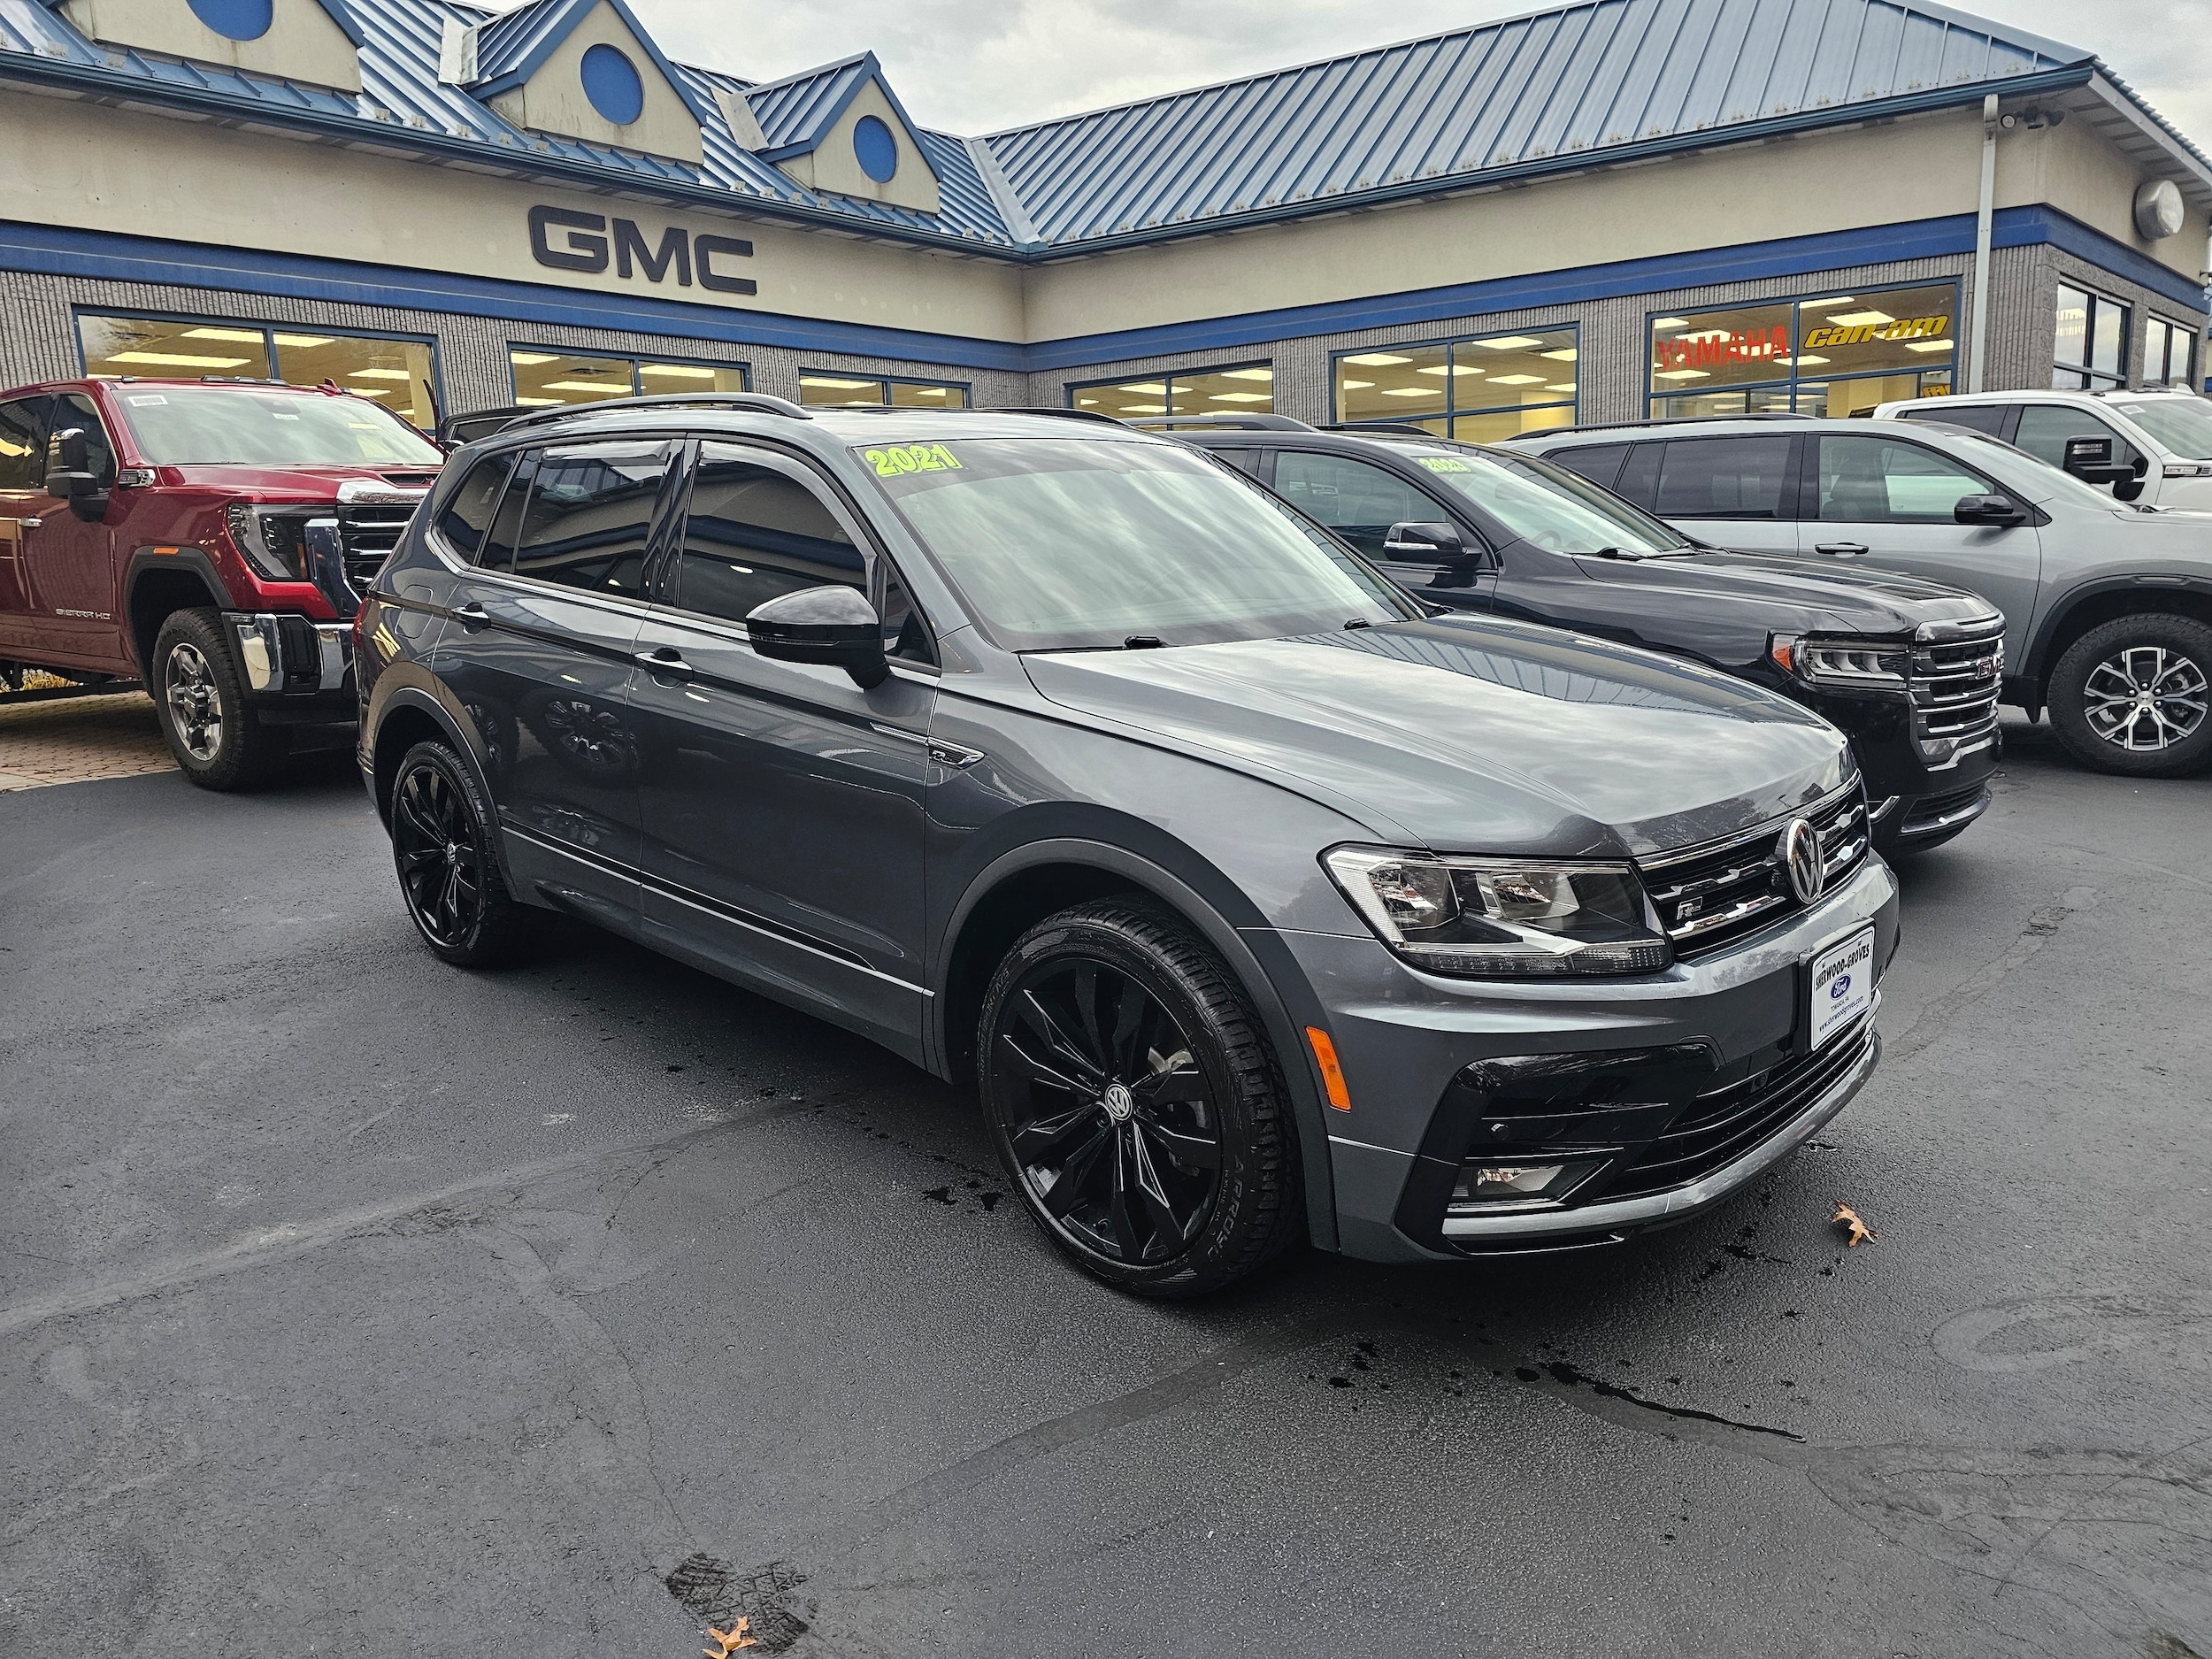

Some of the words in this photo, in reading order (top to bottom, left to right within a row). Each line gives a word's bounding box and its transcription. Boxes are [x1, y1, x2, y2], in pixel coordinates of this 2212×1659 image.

[528, 204, 758, 296] GMC
[1656, 326, 1790, 372] YAMAHA
[1804, 315, 1948, 349] can-am
[865, 444, 963, 478] 2021
[56, 608, 94, 618] SIERRA
[95, 611, 111, 620] HD
[1816, 943, 1870, 991] SHERWOOD-GROVES
[1832, 975, 1850, 999] Ford
[1819, 995, 1863, 1034] www.sherwoodgroves.com
